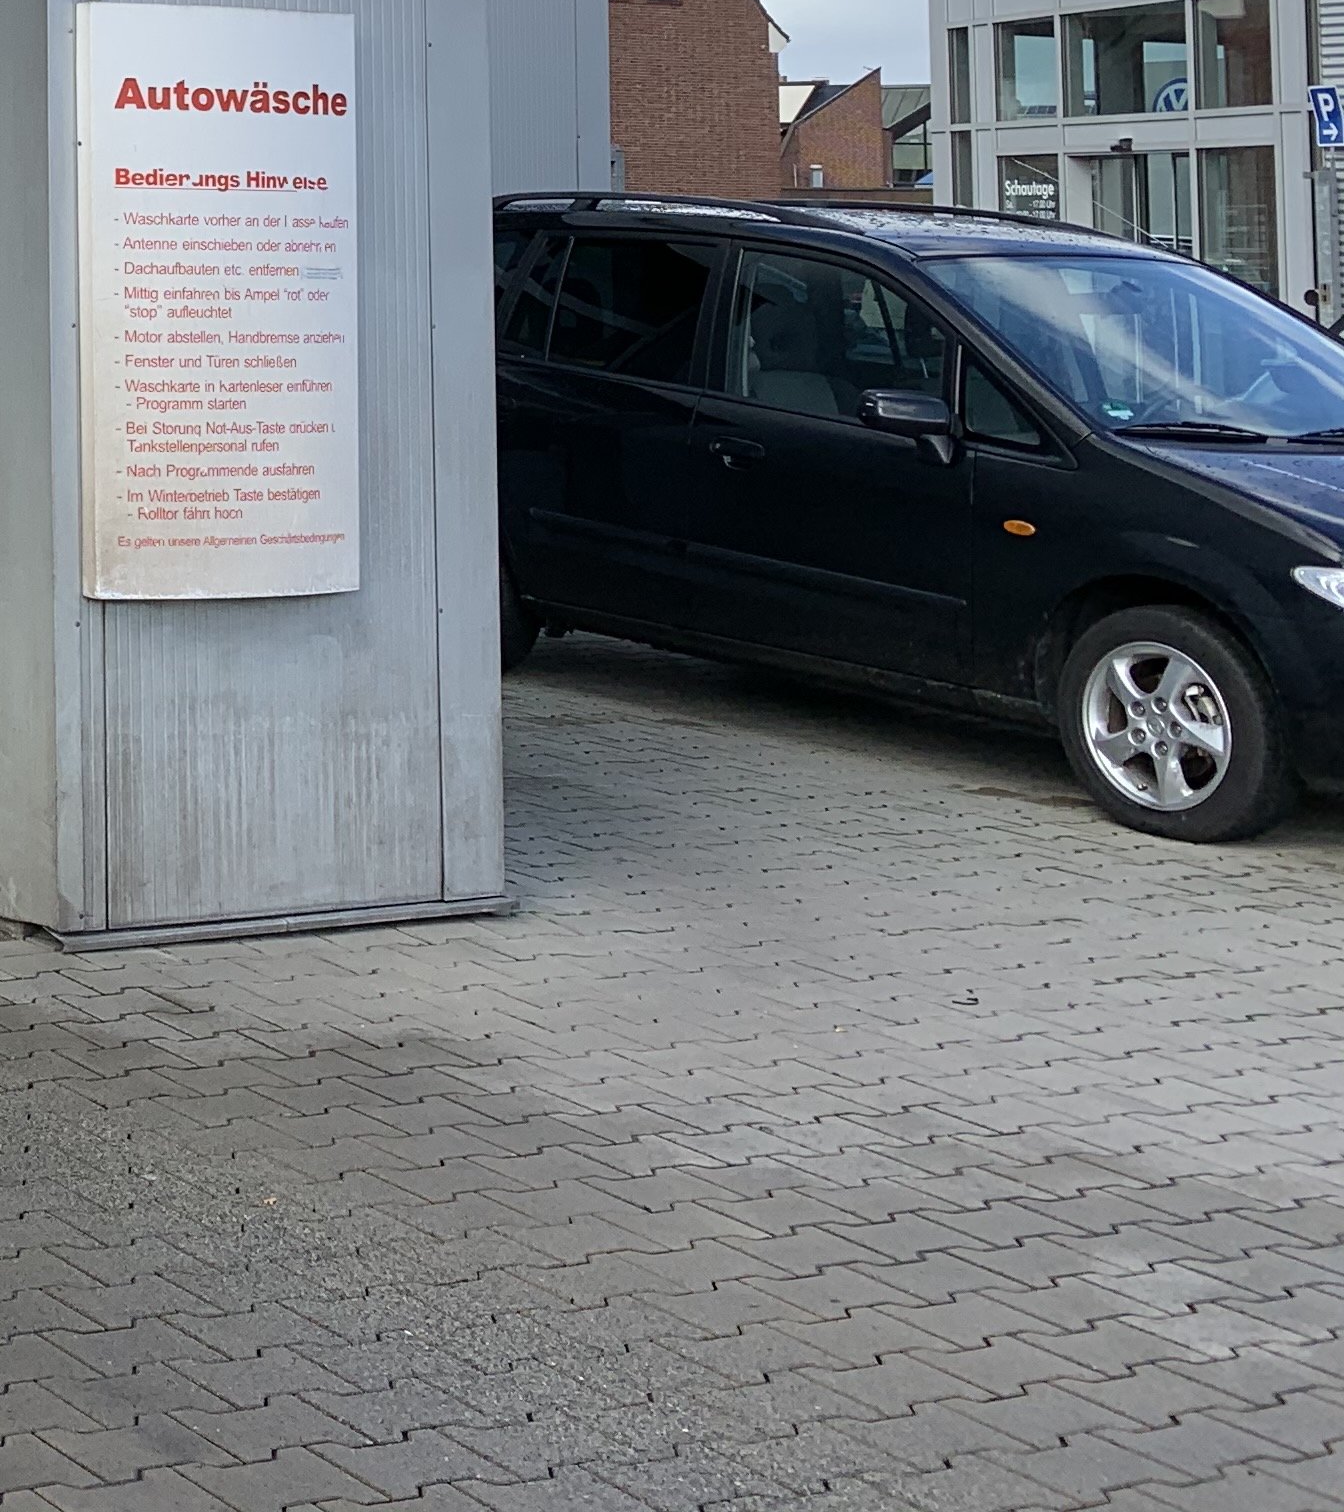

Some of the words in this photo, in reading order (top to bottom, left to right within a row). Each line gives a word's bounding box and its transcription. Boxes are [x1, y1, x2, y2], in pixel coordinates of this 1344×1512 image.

[114, 77, 348, 116] Autowäsche
[1317, 93, 1335, 121] P
[1004, 179, 1055, 199] Schautage
[123, 212, 199, 226] Waschkarte
[204, 214, 241, 226] vorher
[244, 216, 259, 227] an
[263, 215, 281, 227] der
[122, 236, 178, 250] Antenne
[182, 238, 252, 251] einschieben
[256, 239, 281, 252] oder
[124, 261, 220, 275] Dachaufbauten
[249, 263, 299, 276] entfernen
[124, 286, 159, 303] Mittig
[163, 287, 220, 300] einfahren
[224, 288, 241, 301] bis
[244, 288, 279, 304] Ampel
[307, 289, 330, 301] oder
[167, 305, 232, 319] aufleuchtet
[124, 330, 163, 343] Motor
[228, 331, 300, 343] Handbremse
[125, 354, 175, 368] Fenster
[179, 355, 202, 368] und
[244, 355, 297, 368] schließen
[124, 379, 200, 393] Waschkarte
[205, 379, 215, 392] in
[136, 397, 203, 413] Programm
[207, 398, 247, 410] starten
[126, 421, 147, 434] Bei
[206, 421, 285, 434] Not-Aus-Taste
[127, 439, 247, 456] Tankstellenpersonal
[251, 438, 279, 452] rufen
[127, 464, 161, 477] Nach
[167, 464, 258, 480] Programmende
[262, 463, 315, 476] ausfahren
[127, 489, 143, 502] Im
[233, 488, 263, 502] Taste
[138, 506, 179, 520] Rolltor
